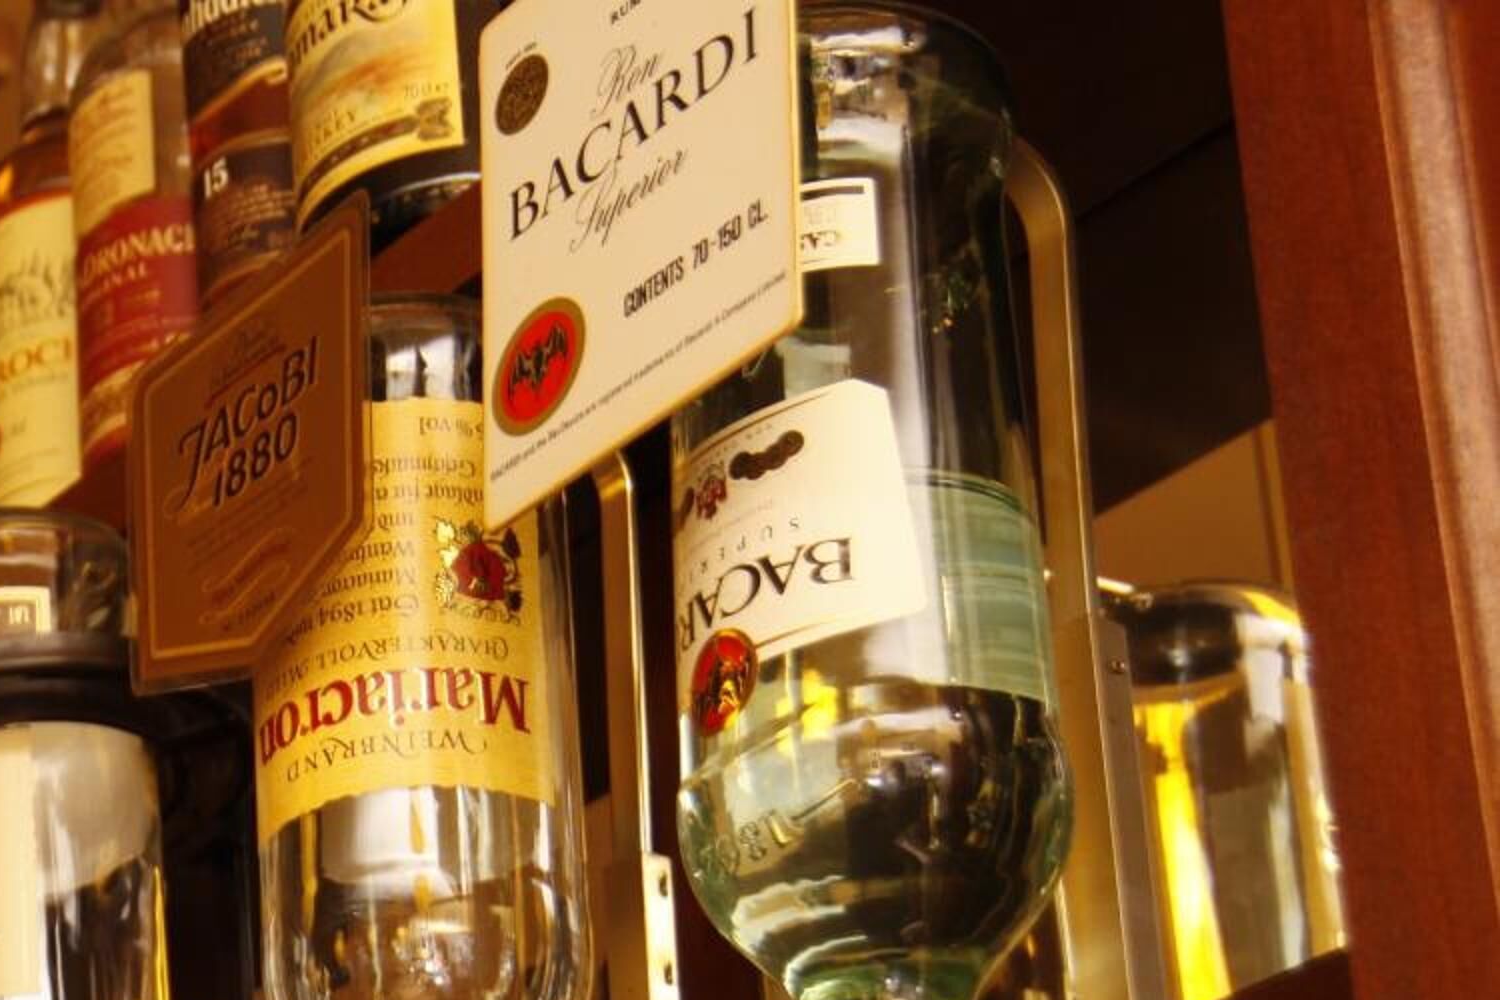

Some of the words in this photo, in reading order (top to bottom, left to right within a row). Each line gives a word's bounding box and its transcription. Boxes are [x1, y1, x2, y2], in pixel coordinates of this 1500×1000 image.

[509, 8, 758, 241] BACARDI
[591, 45, 663, 118] Ron
[204, 157, 230, 198] 15
[570, 148, 687, 255] Superior
[622, 256, 685, 317] CONTENTS
[178, 335, 320, 514] JACOBI
[213, 412, 298, 507] 1880
[259, 665, 532, 767] Mariacron
[286, 728, 489, 784] WEINBRAND
